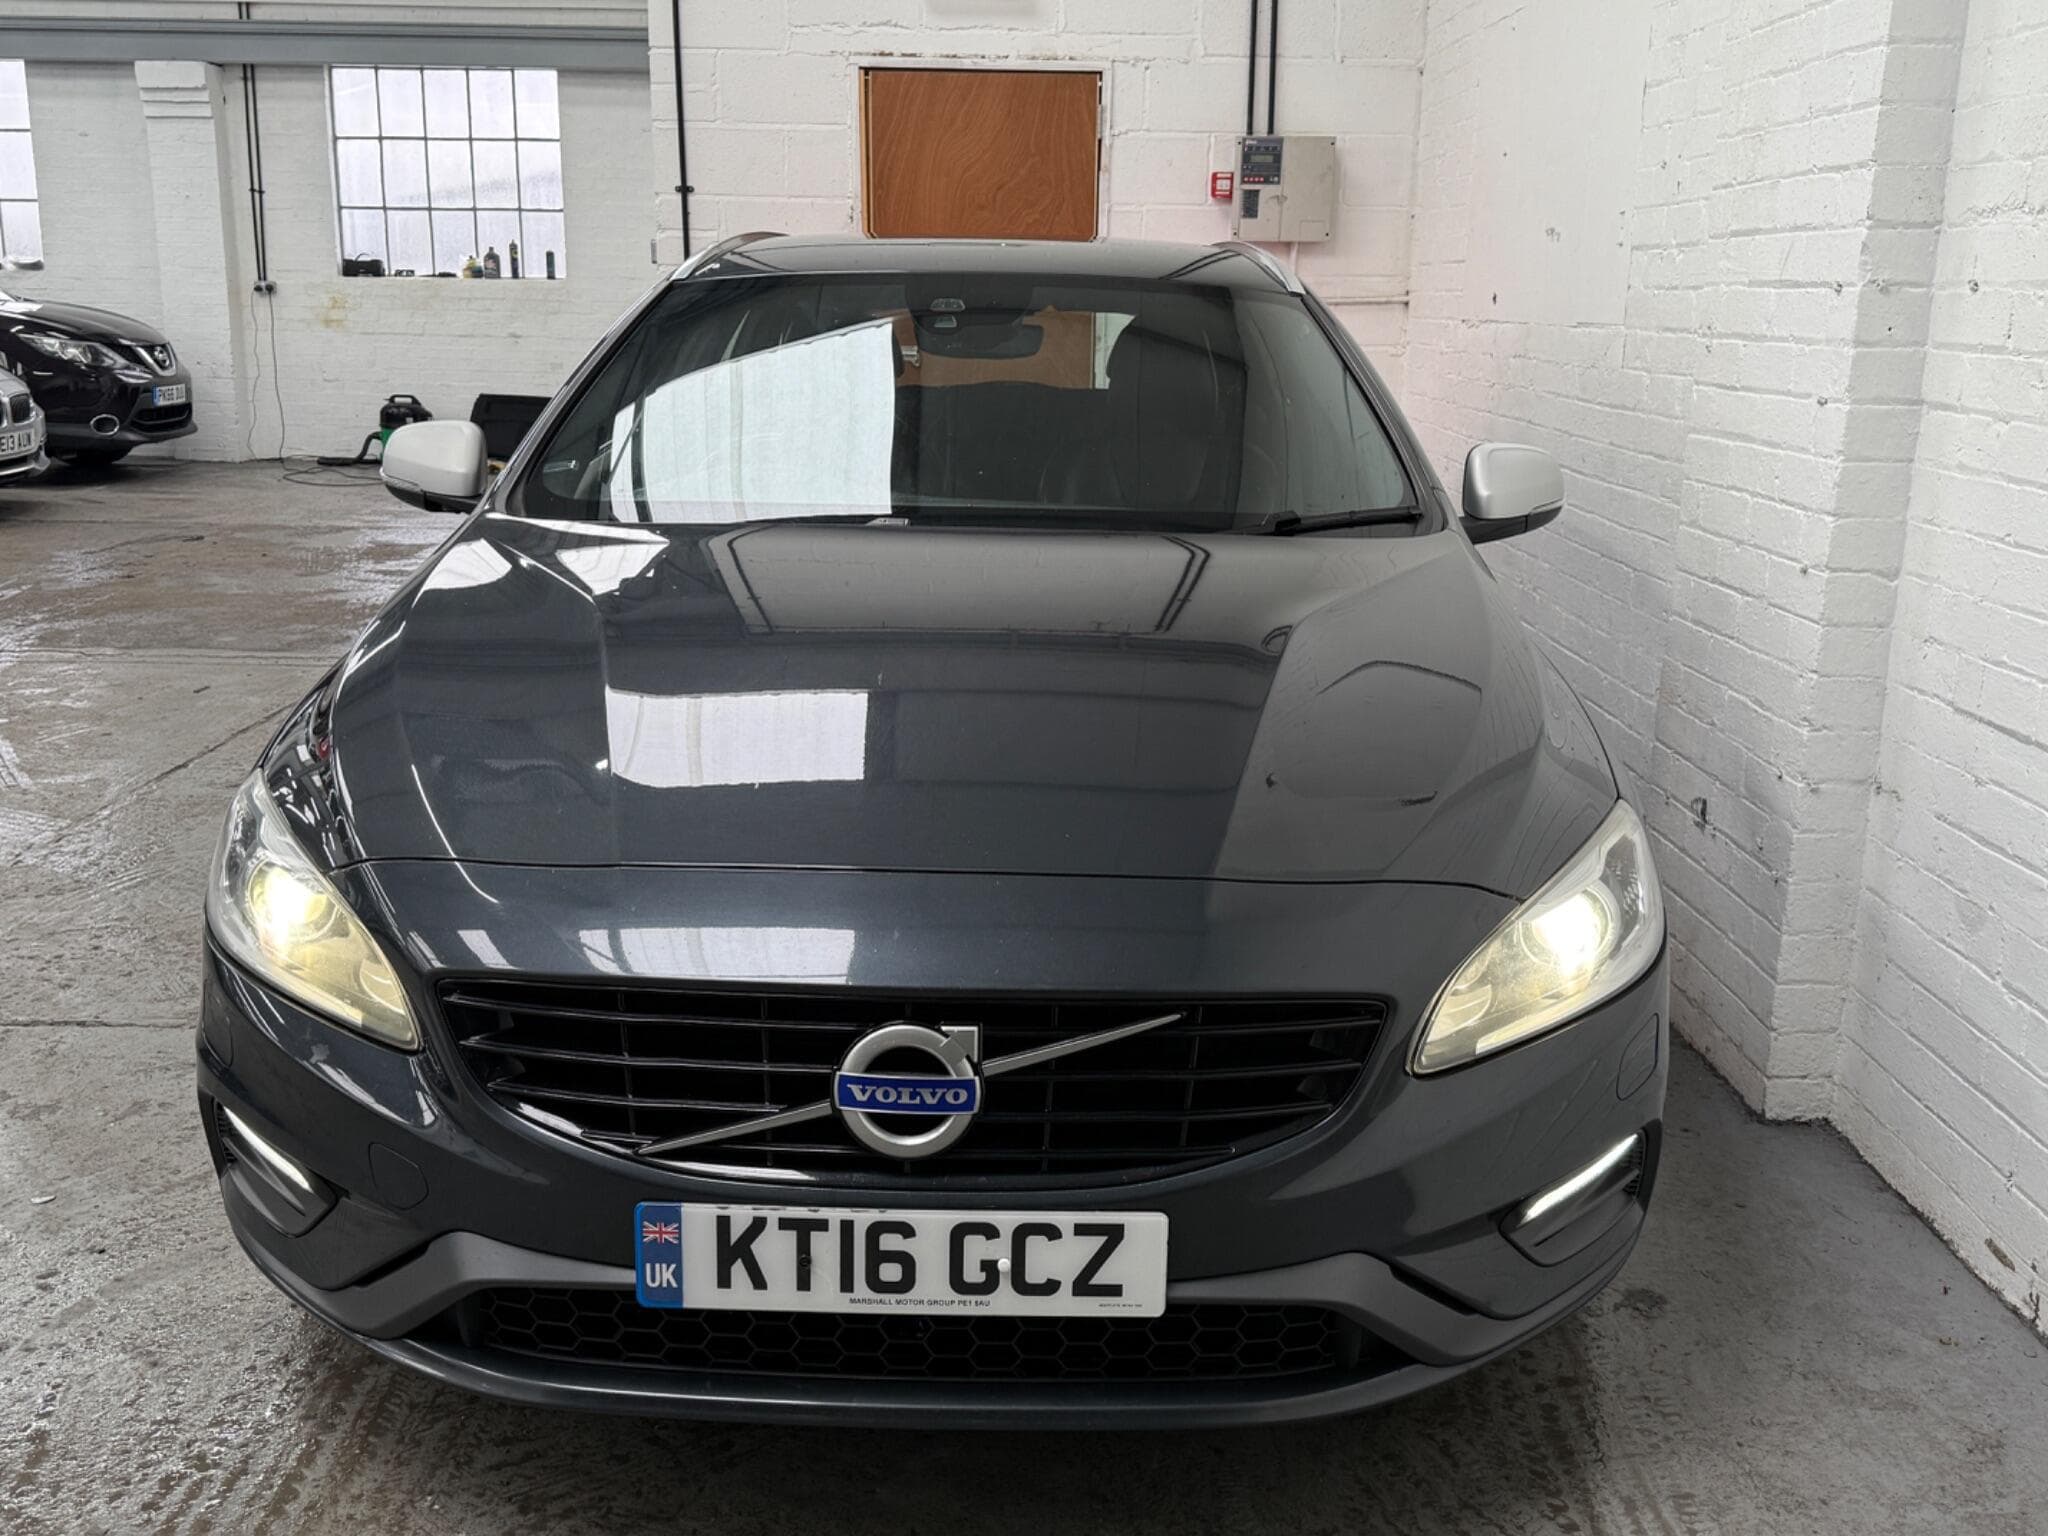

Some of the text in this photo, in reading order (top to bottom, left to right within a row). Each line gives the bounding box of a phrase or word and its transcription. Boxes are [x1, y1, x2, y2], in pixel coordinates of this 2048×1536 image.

[846, 1084, 968, 1105] VOLVO
[716, 1215, 1126, 1298] KT16 GCZ
[645, 1263, 678, 1288] UK
[849, 1296, 893, 1306] MARSHALL
[895, 1298, 925, 1306] MOTOR
[926, 1299, 956, 1307] GROUP
[957, 1299, 972, 1307] PE1
